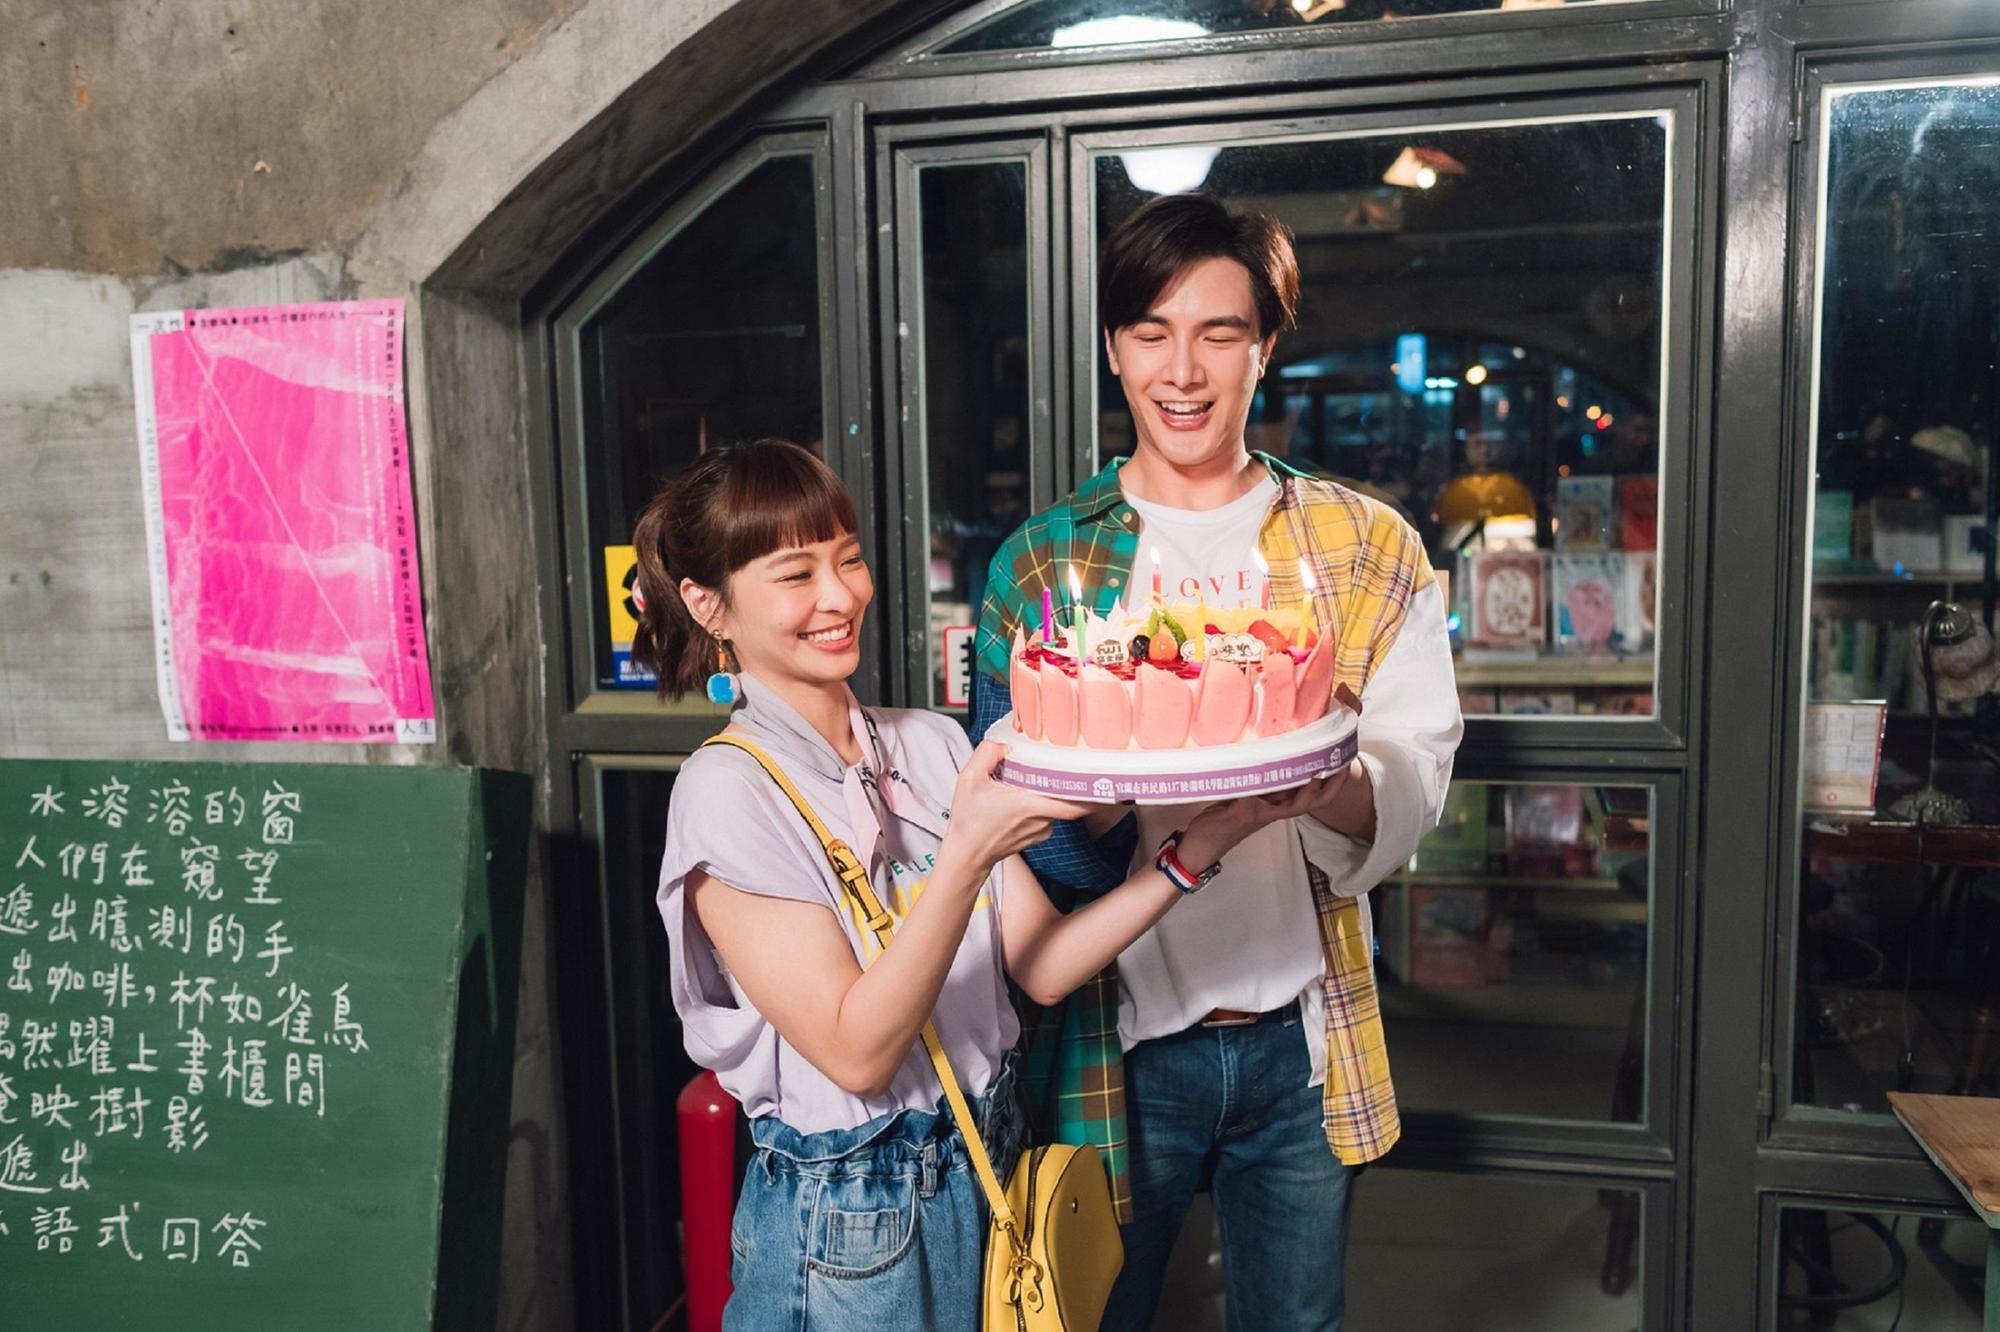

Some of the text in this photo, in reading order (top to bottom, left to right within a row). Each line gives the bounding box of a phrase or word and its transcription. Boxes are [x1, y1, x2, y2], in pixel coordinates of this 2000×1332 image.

[1155, 570, 1251, 598] OVE
[30, 776, 301, 844] 水溶溶的窗
[16, 836, 282, 905] 人們在窺望
[0, 1202, 267, 1268] 語式回答
